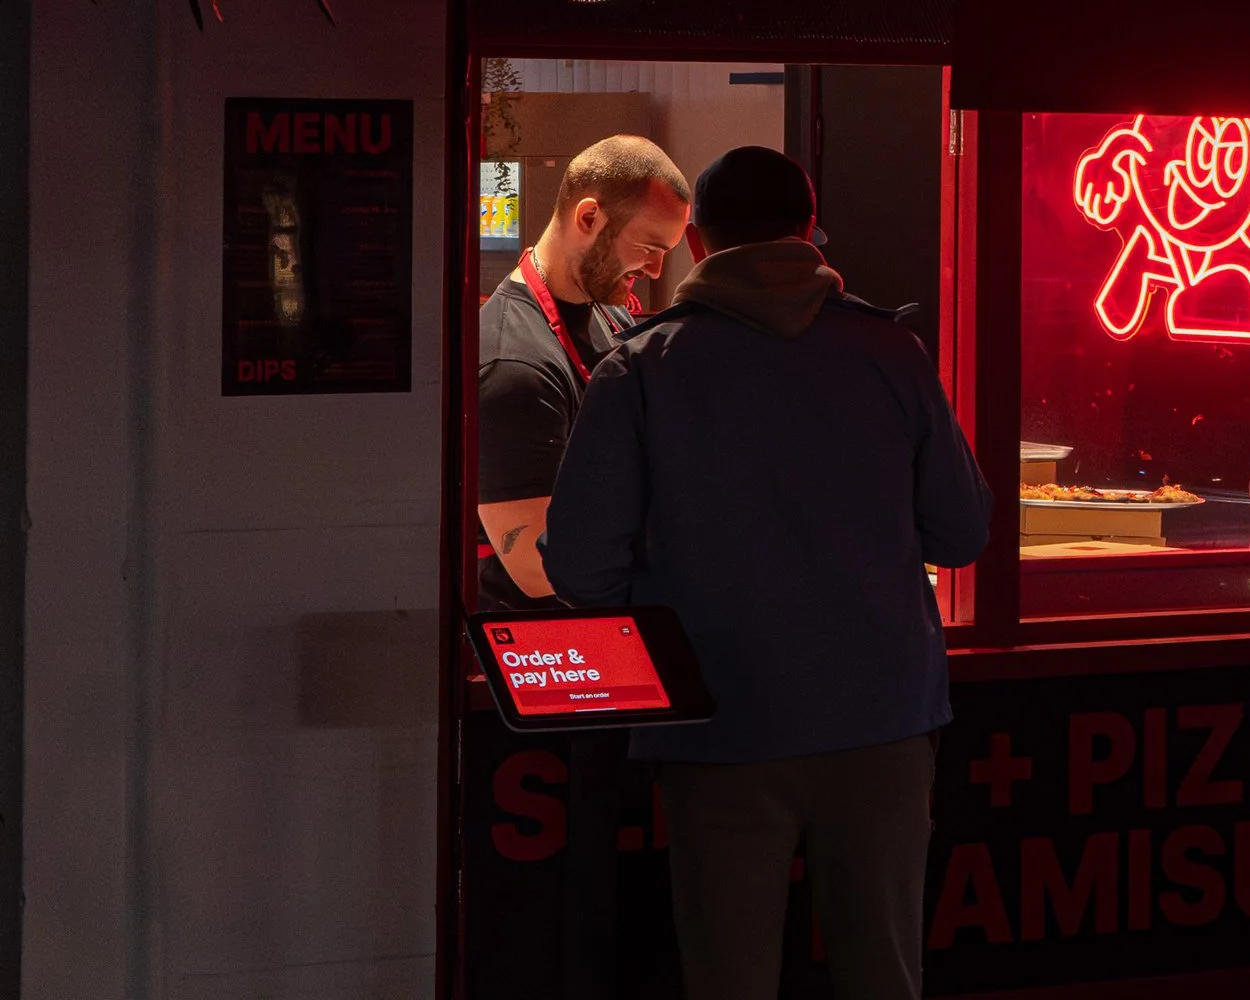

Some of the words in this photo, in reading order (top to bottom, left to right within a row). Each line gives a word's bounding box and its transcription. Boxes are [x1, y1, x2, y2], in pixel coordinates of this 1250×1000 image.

[247, 109, 393, 154] MENU
[236, 359, 298, 383] DIPS
[502, 650, 564, 667] Order
[568, 648, 586, 665] &
[510, 670, 548, 689] pay
[550, 666, 601, 683] here
